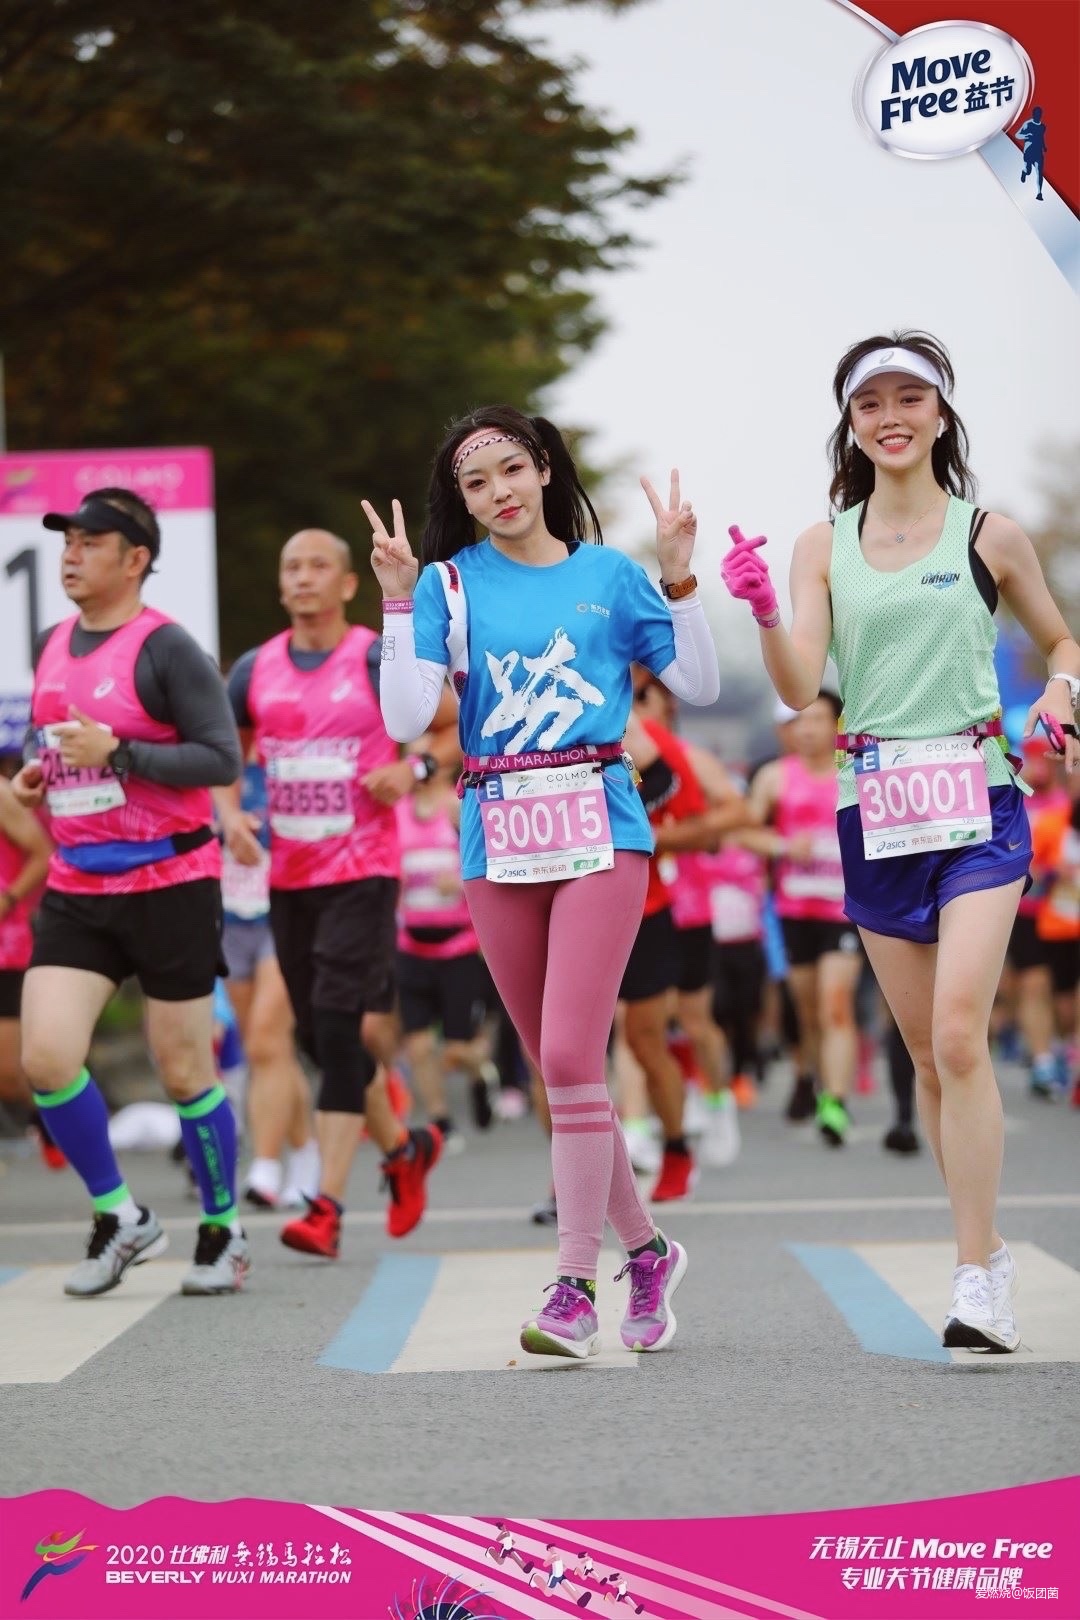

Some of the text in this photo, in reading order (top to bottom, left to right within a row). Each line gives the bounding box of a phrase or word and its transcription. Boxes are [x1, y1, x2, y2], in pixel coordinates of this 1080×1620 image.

[926, 743, 968, 752] COLMO
[514, 749, 587, 767] MARATHON
[862, 750, 876, 771] E
[546, 770, 588, 782] COLMO
[486, 780, 500, 799] E
[862, 769, 976, 823] 30001
[487, 796, 602, 849] 30015
